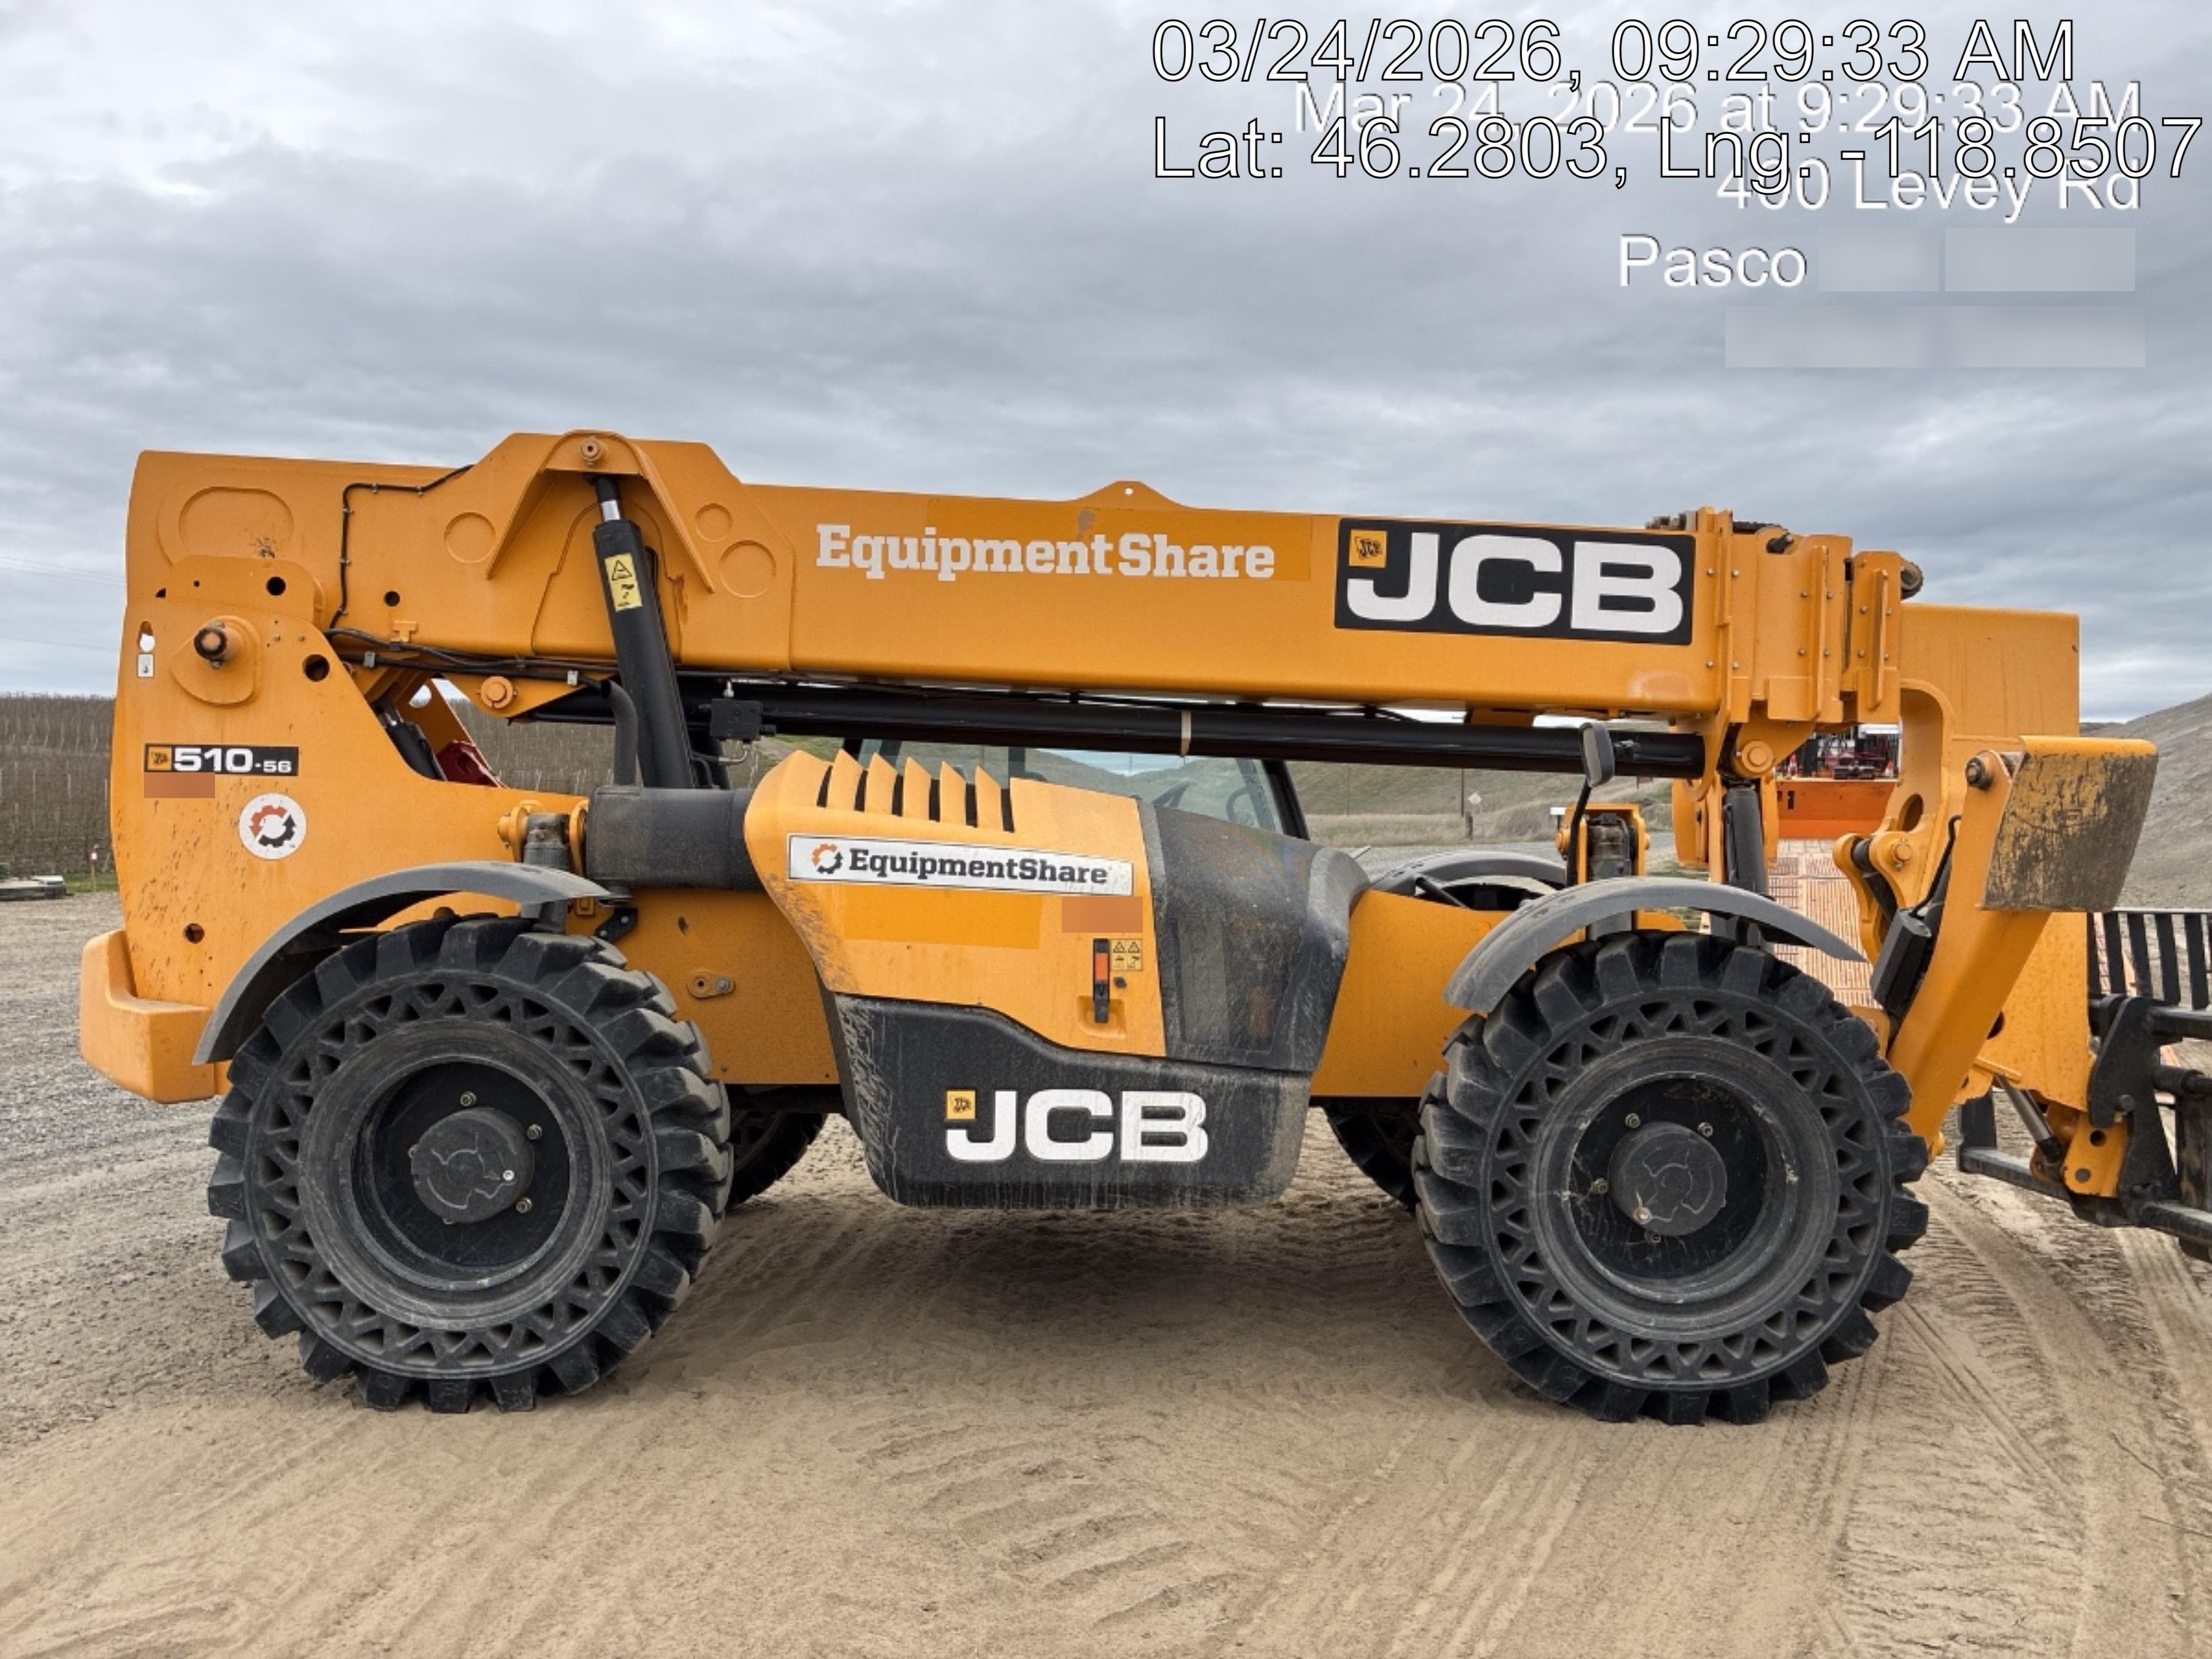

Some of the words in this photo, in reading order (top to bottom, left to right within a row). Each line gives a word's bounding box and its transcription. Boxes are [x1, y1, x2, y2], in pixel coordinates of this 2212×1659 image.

[1346, 531, 1684, 633] JCB
[173, 747, 292, 773] 510-56
[849, 848, 1108, 885] EquipmentShare
[946, 1089, 1209, 1162] JCB
